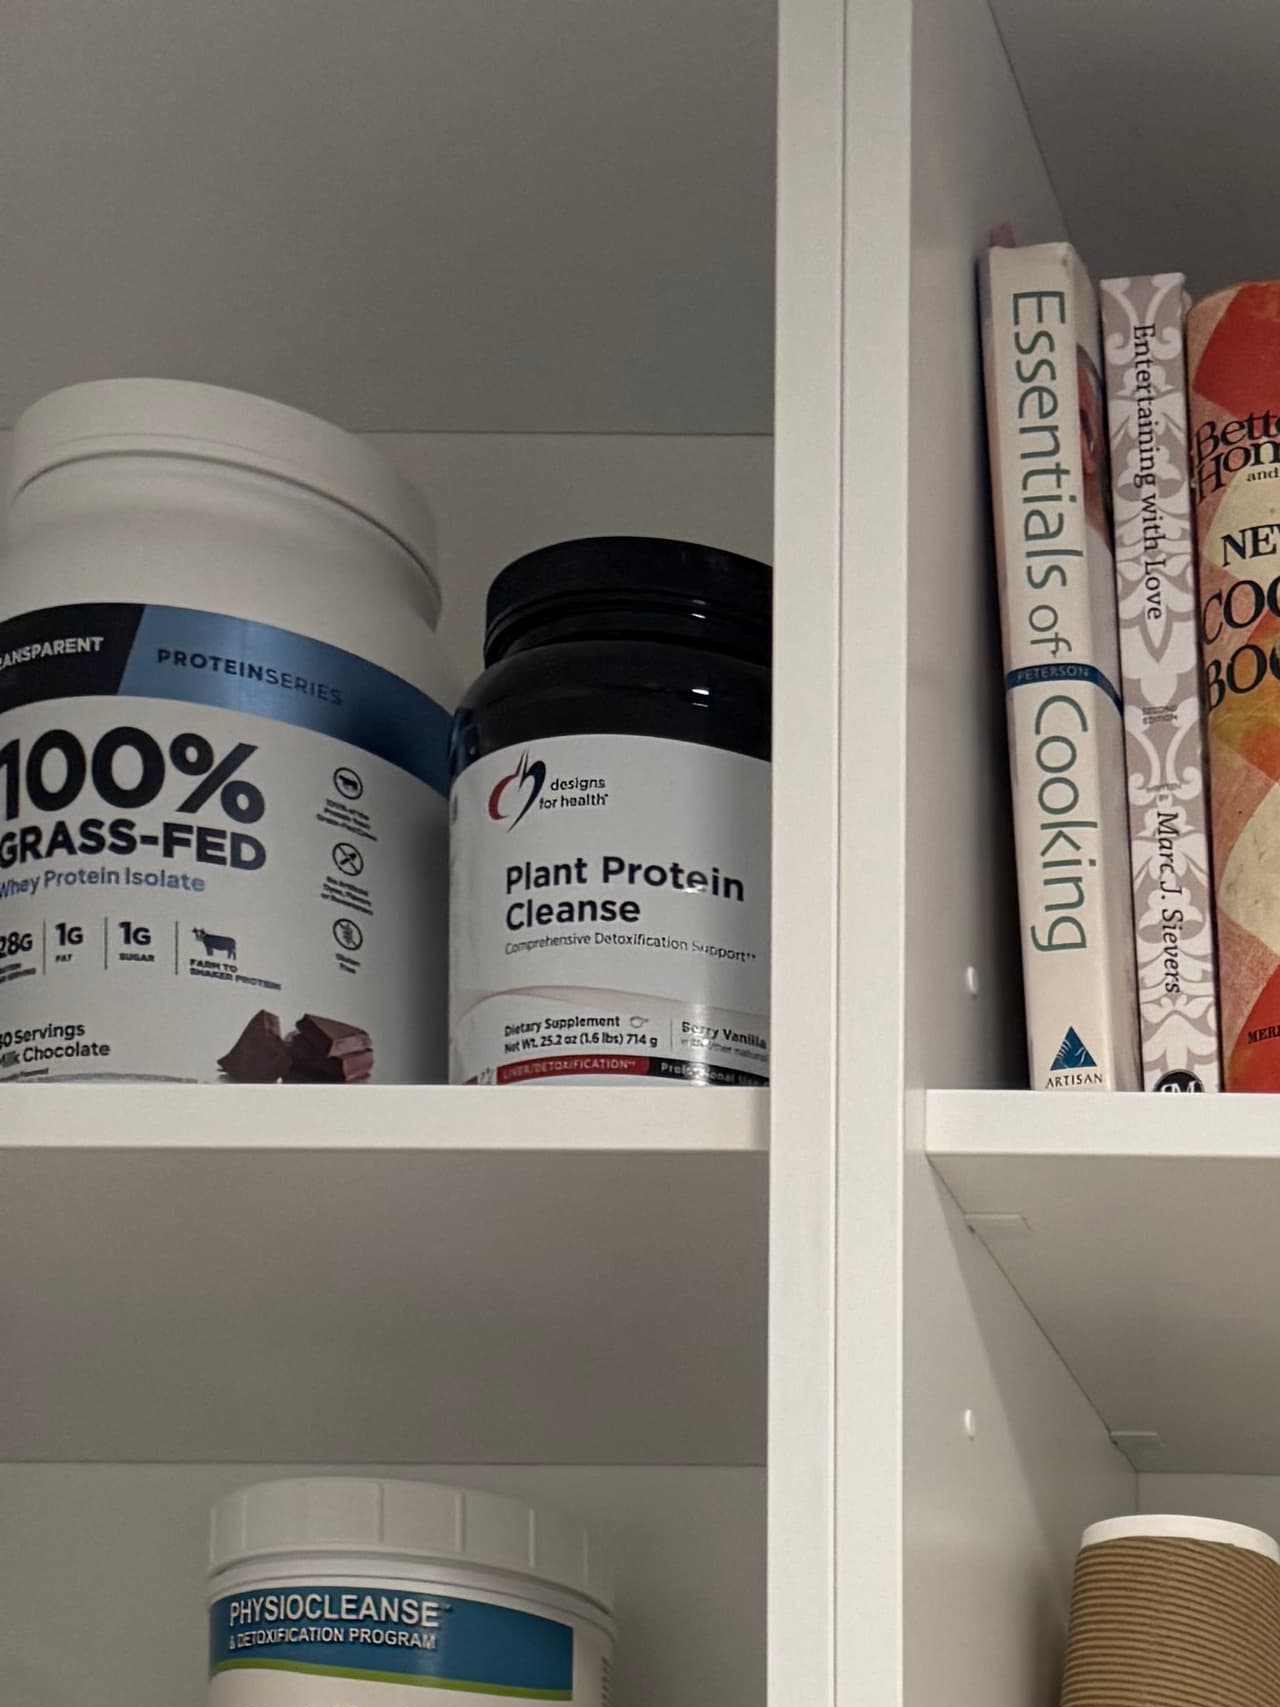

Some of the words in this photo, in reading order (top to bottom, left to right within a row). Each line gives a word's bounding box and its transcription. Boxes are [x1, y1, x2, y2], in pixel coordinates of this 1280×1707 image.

[1132, 323, 1155, 489] Entertaining
[1013, 289, 1083, 589] Essentials
[1142, 493, 1166, 552] with
[1143, 558, 1167, 623] Love
[1028, 605, 1072, 655] of
[157, 648, 344, 707] PROTEINSERIES
[1016, 665, 1090, 683] PETERSON
[0, 726, 267, 825] 100%
[549, 775, 606, 793] designs
[538, 796, 558, 811] for
[1030, 694, 1099, 953] Cooking
[0, 818, 268, 871] GRASS-FED
[1155, 810, 1178, 873] Marc
[43, 867, 120, 889] Protein
[125, 867, 206, 893] Isolate
[505, 857, 588, 895] Plant
[602, 856, 745, 902] Protein
[1159, 877, 1182, 901] J.
[506, 898, 641, 932] Cleanse
[55, 922, 84, 947] 1G
[119, 920, 152, 946] 1G
[1161, 908, 1184, 995] Sievers
[14, 1022, 86, 1045] Servings
[504, 1020, 542, 1037] Dietary
[545, 1015, 620, 1030] Supplement
[23, 1041, 111, 1064] Chocolate
[1045, 1071, 1103, 1089] ARTISAN
[229, 1593, 440, 1629] PHYSIOCLEANSE
[237, 1626, 345, 1649] DETOXIFICATION
[348, 1628, 437, 1651] PROGRAM
